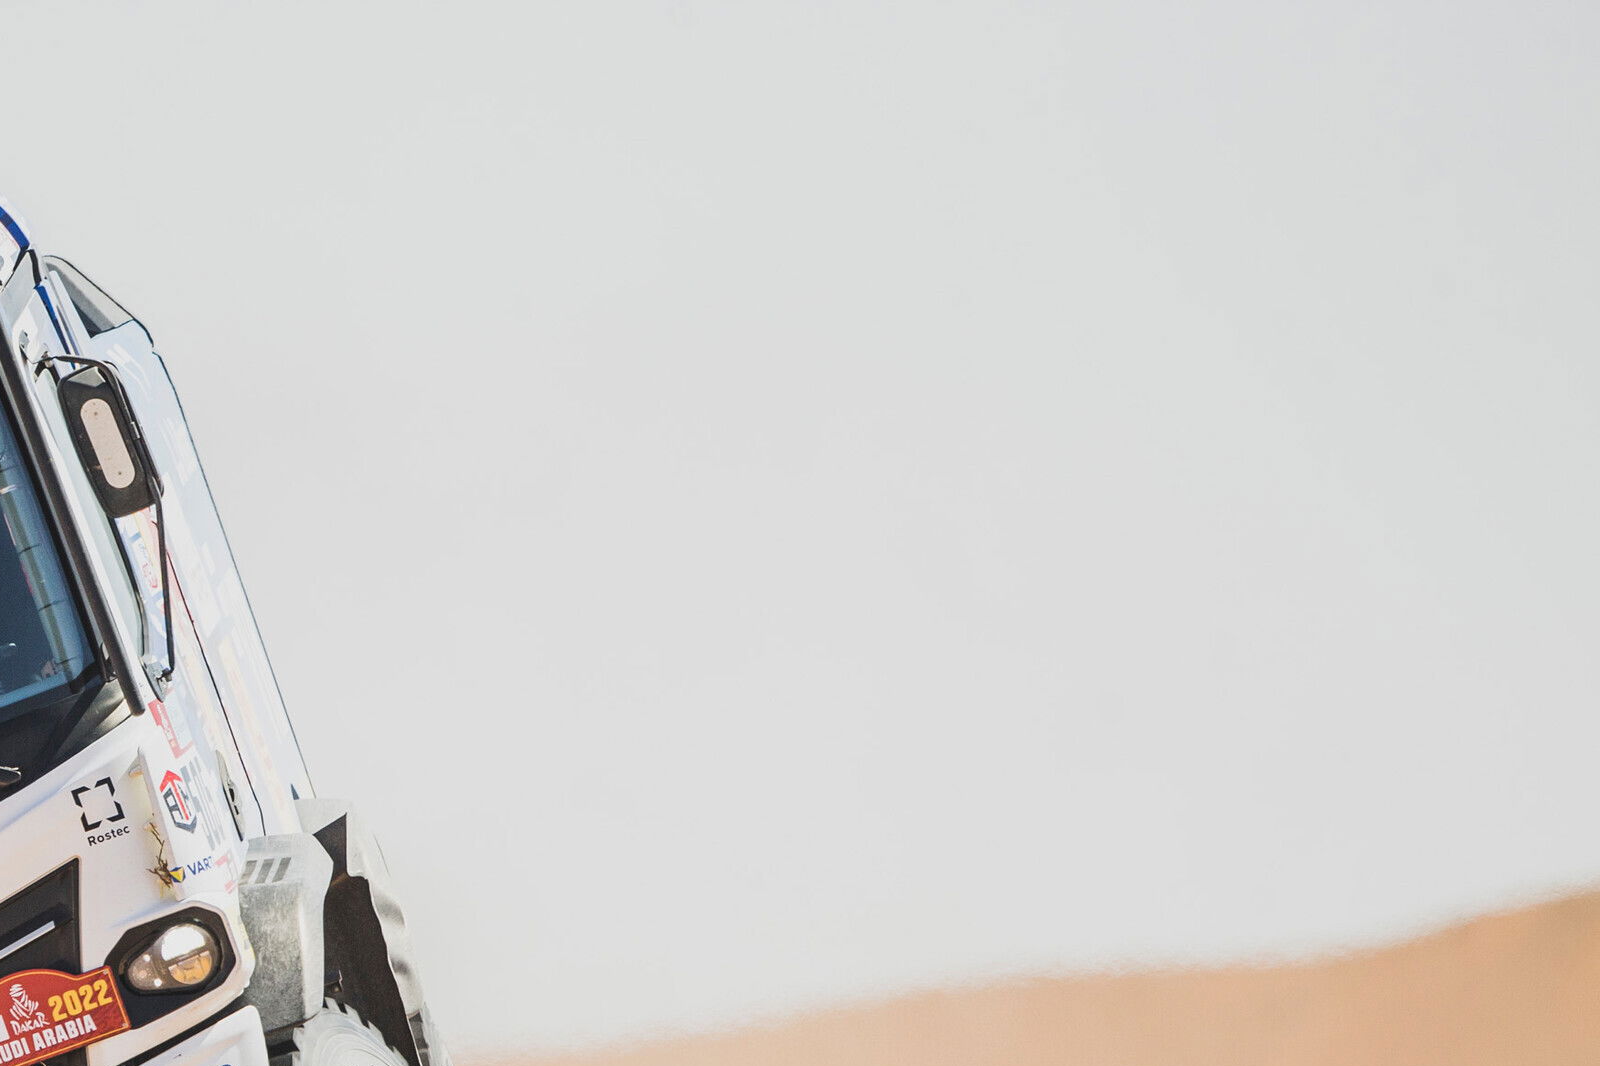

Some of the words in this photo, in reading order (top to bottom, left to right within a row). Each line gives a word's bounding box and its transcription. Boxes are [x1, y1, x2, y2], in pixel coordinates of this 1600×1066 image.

[87, 824, 130, 847] Rostec
[10, 1013, 50, 1036] DAKAR
[47, 979, 113, 1023] 2022
[34, 1014, 97, 1052] ARABIA
